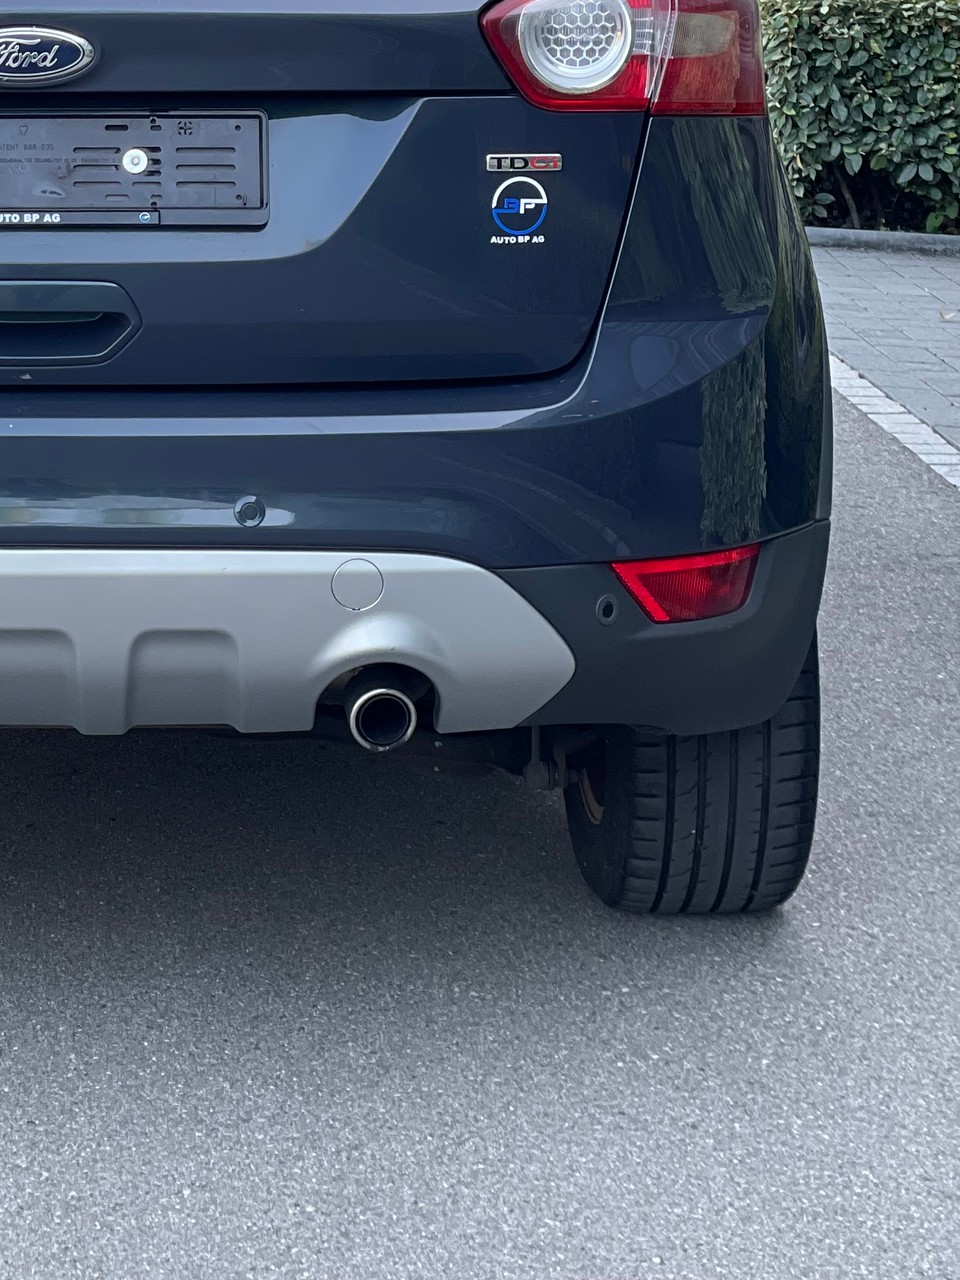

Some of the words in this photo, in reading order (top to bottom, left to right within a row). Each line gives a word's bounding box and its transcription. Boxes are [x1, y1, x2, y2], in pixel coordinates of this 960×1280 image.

[23, 213, 40, 223] BP
[43, 213, 61, 223] AG
[490, 236, 517, 244] AUTO
[518, 235, 531, 243] BP
[531, 235, 545, 243] AG
